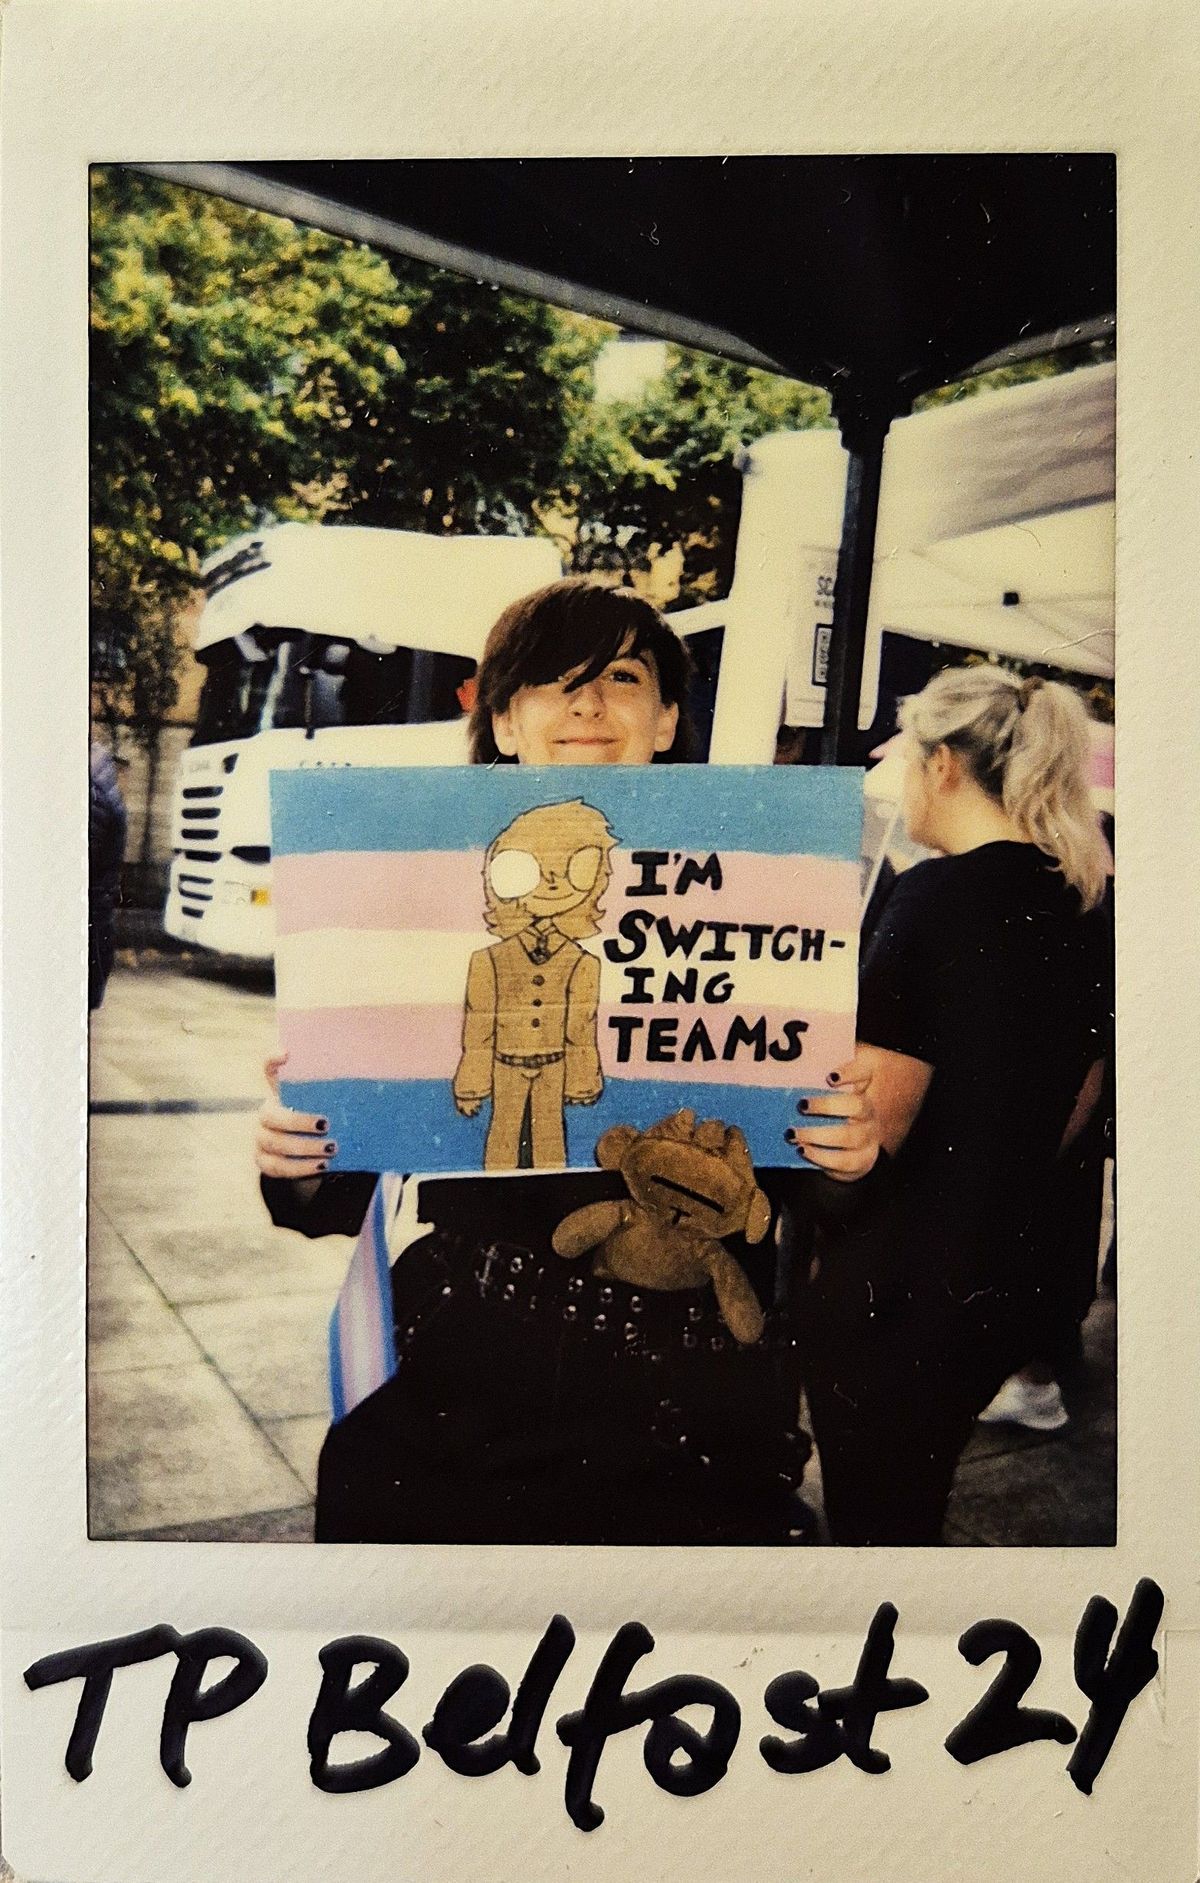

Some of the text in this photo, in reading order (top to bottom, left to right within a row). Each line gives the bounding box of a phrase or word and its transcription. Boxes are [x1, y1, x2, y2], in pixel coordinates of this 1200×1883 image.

[625, 850, 723, 897] I'M
[603, 908, 847, 963] SWITCH-
[620, 966, 735, 1005] ING
[607, 1014, 809, 1063] TEAMS
[22, 1577, 1165, 1833] TP Belfast 24
